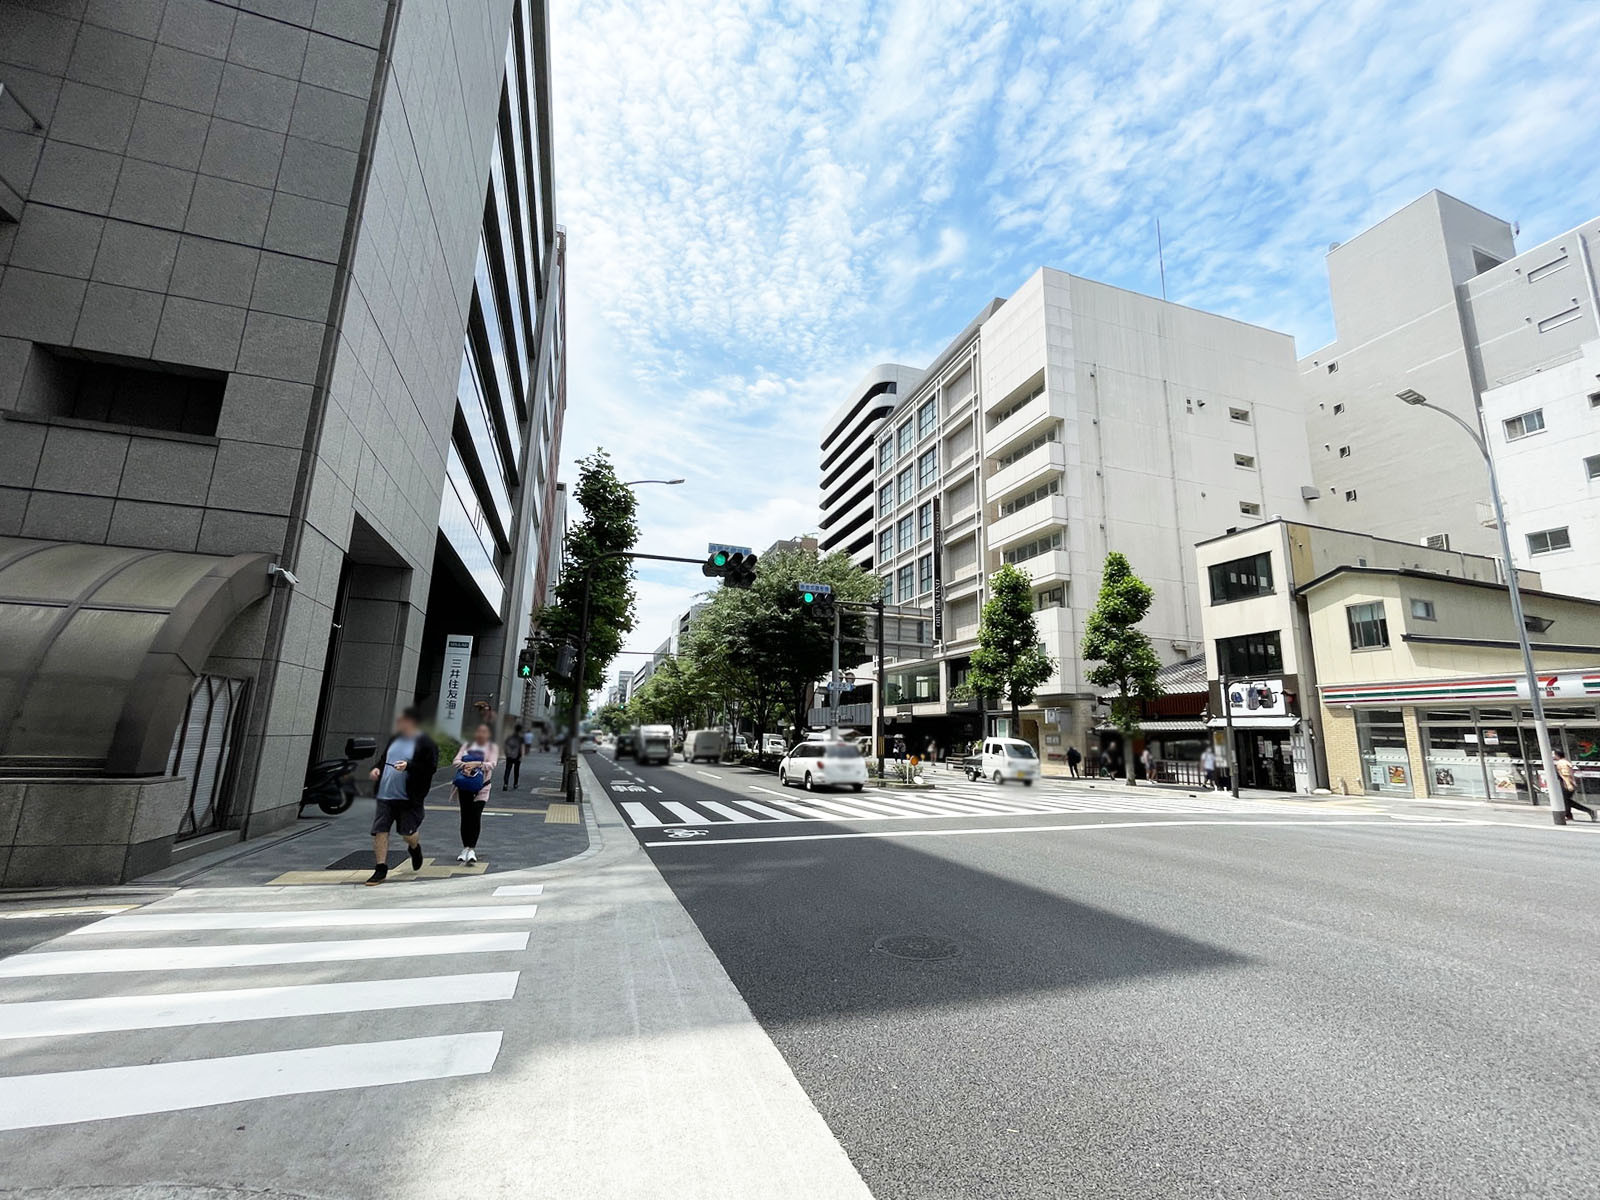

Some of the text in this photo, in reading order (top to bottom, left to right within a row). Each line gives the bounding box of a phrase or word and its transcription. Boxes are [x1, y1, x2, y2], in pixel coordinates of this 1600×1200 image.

[445, 658, 462, 720] 三井住友海上
